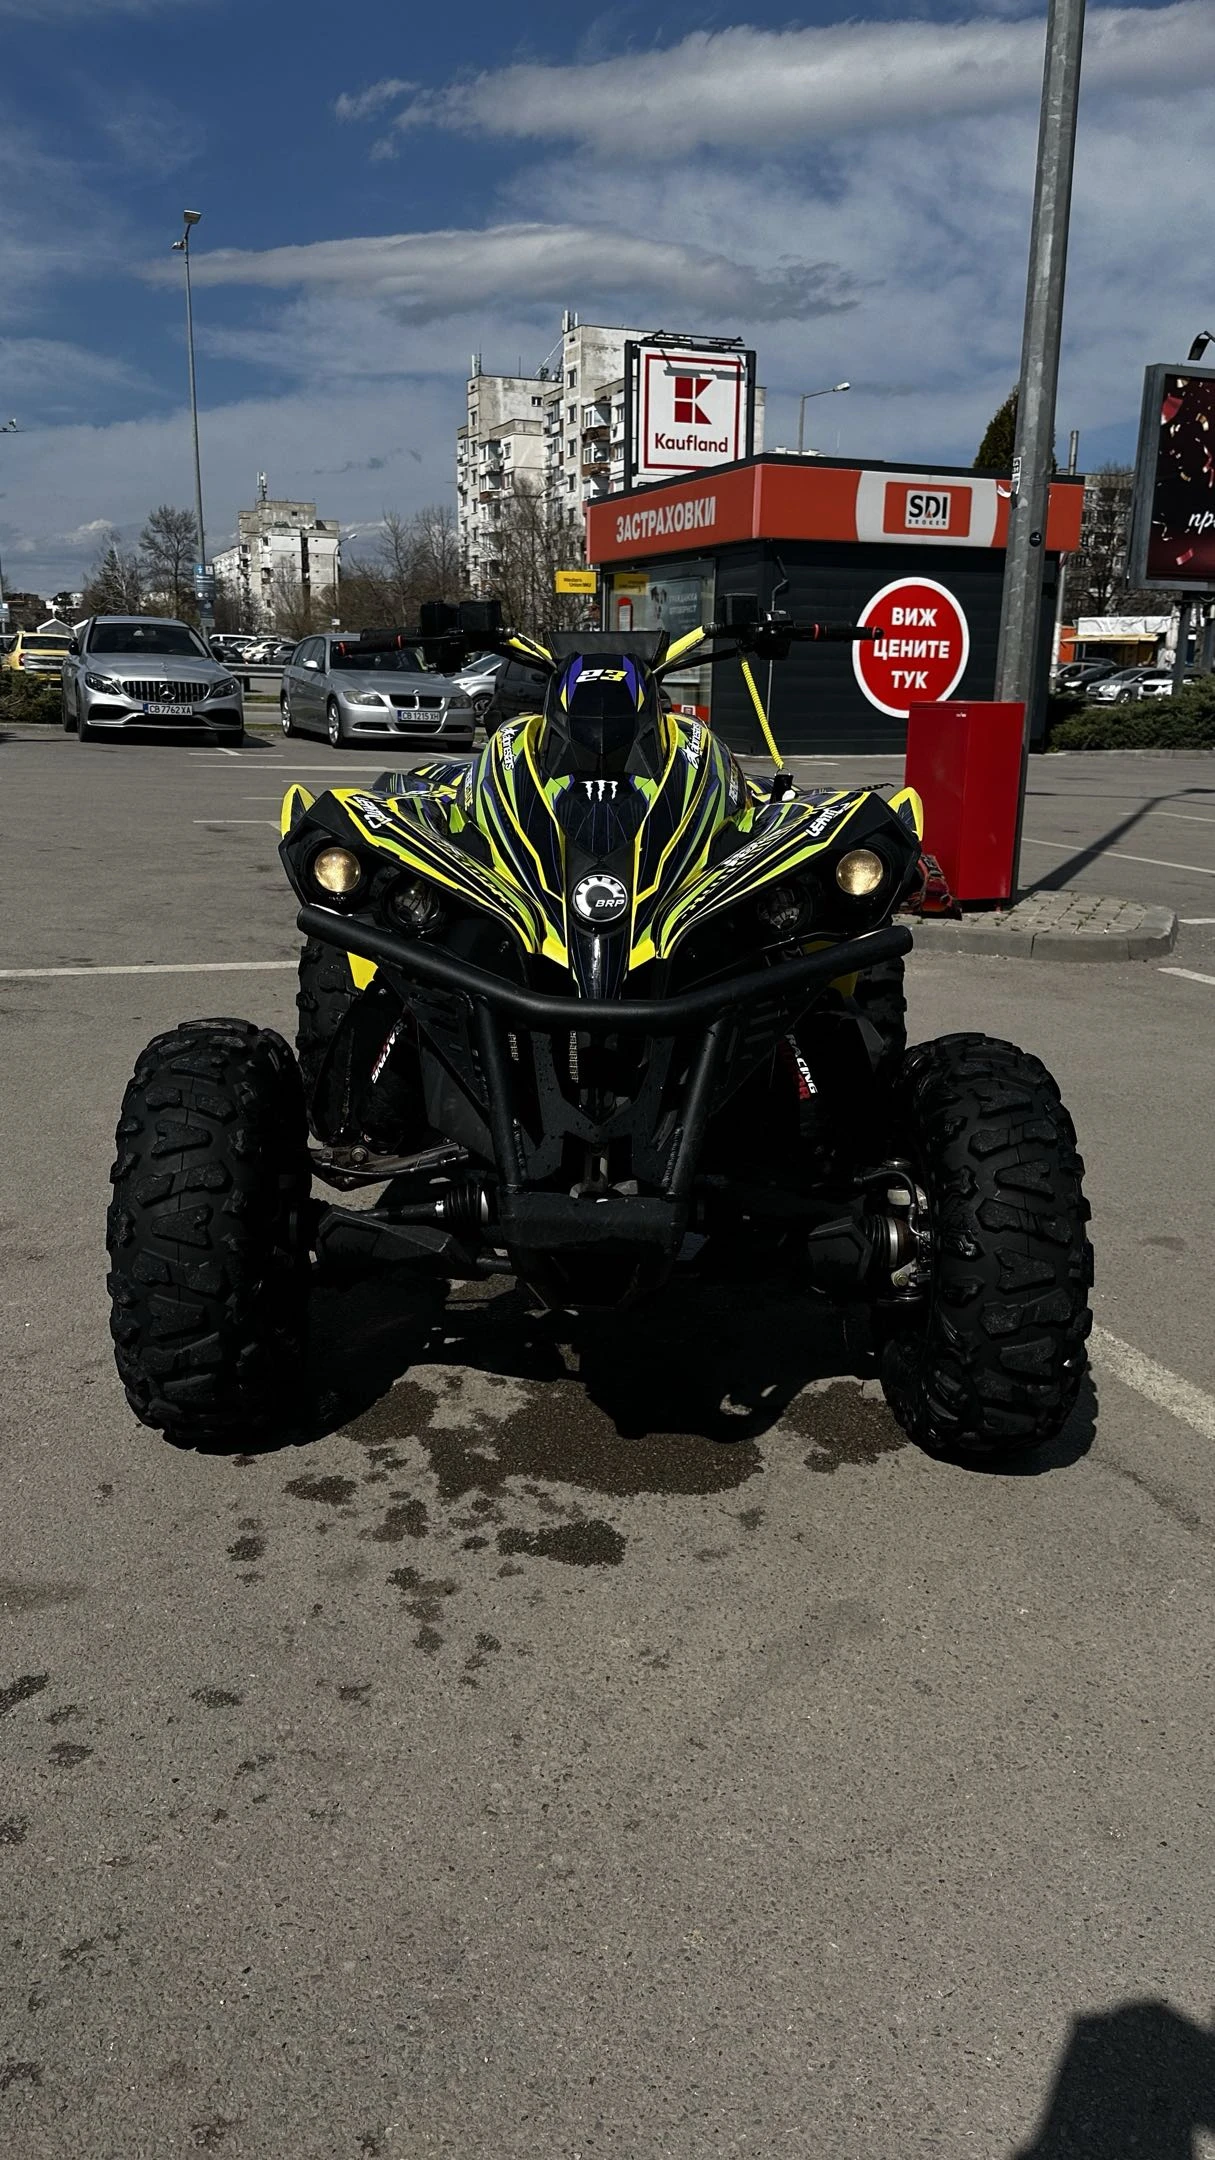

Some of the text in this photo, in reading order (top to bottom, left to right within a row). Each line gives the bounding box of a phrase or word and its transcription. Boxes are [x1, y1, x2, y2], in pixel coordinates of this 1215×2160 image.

[654, 432, 729, 454] Kaufland
[909, 495, 948, 519] SDI
[615, 496, 716, 543] ЗАСТРАХОВКИ
[1187, 509, 1215, 535] пр
[891, 606, 938, 628] ВИЖ
[872, 637, 951, 661] ЦЕНИТЕ
[575, 668, 628, 683] 23
[891, 668, 930, 690] ТУК
[594, 898, 625, 907] BRP
[784, 1032, 818, 1095] RACING
